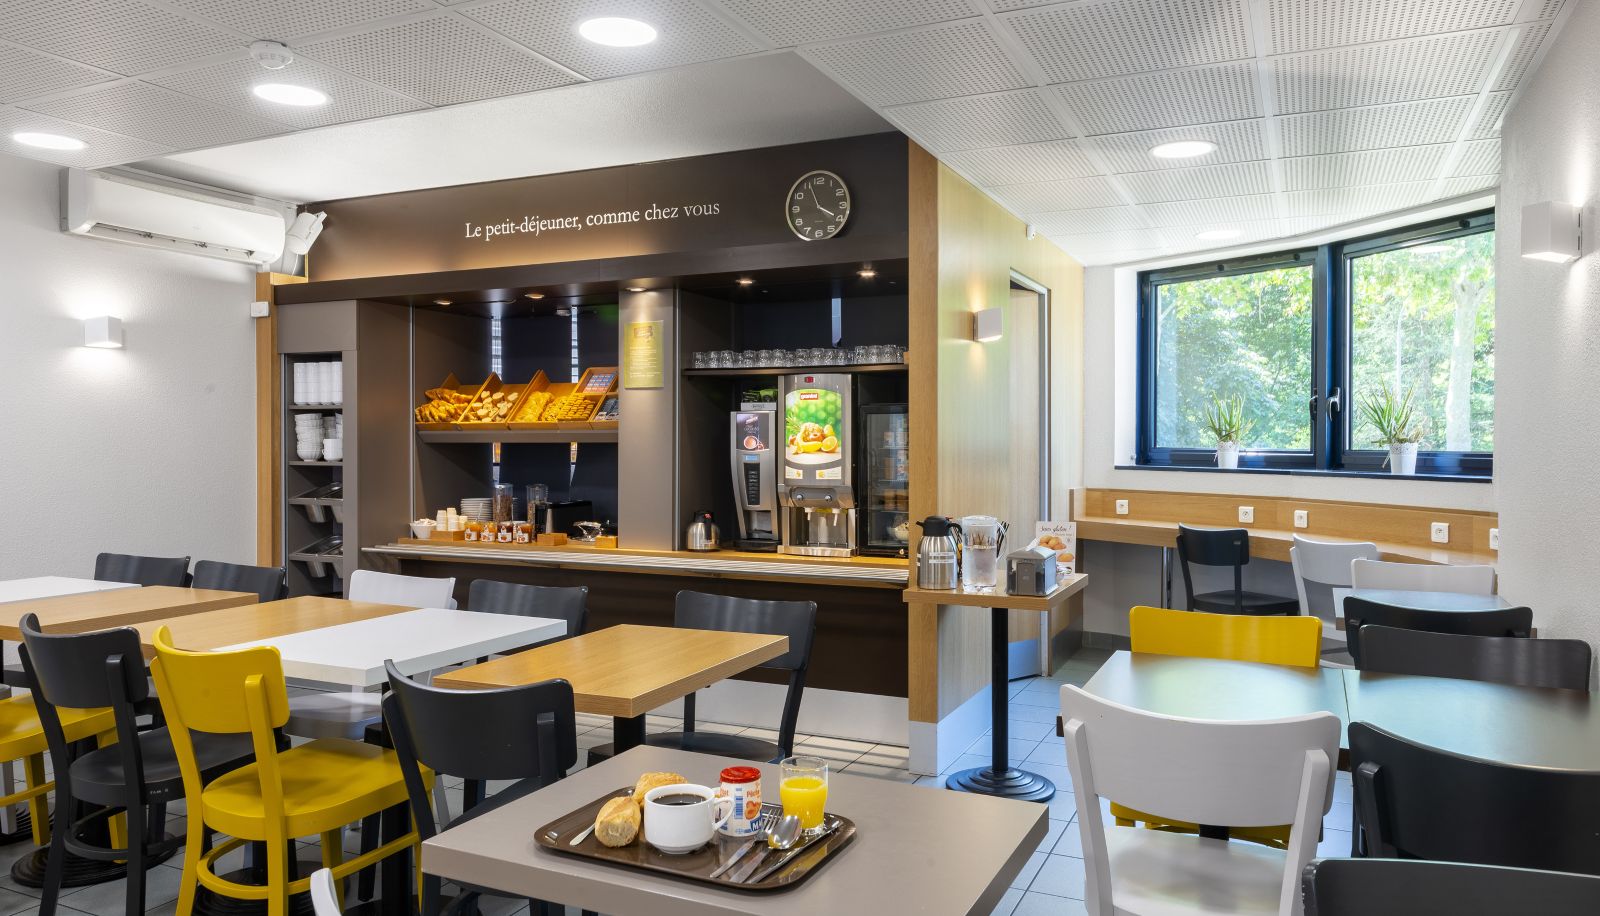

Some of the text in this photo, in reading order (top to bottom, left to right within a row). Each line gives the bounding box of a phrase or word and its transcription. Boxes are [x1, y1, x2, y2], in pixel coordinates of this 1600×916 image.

[813, 176, 825, 185] 12
[794, 192, 804, 200] 10
[835, 188, 845, 197] 2
[791, 205, 800, 213] 9
[838, 201, 847, 209] 3
[795, 218, 803, 226] 8
[835, 214, 844, 222] 4
[465, 203, 720, 242] Le petit-déjeuner, comme chez vous
[803, 226, 812, 235] 7
[826, 225, 836, 233] 5
[814, 229, 824, 238] 6
